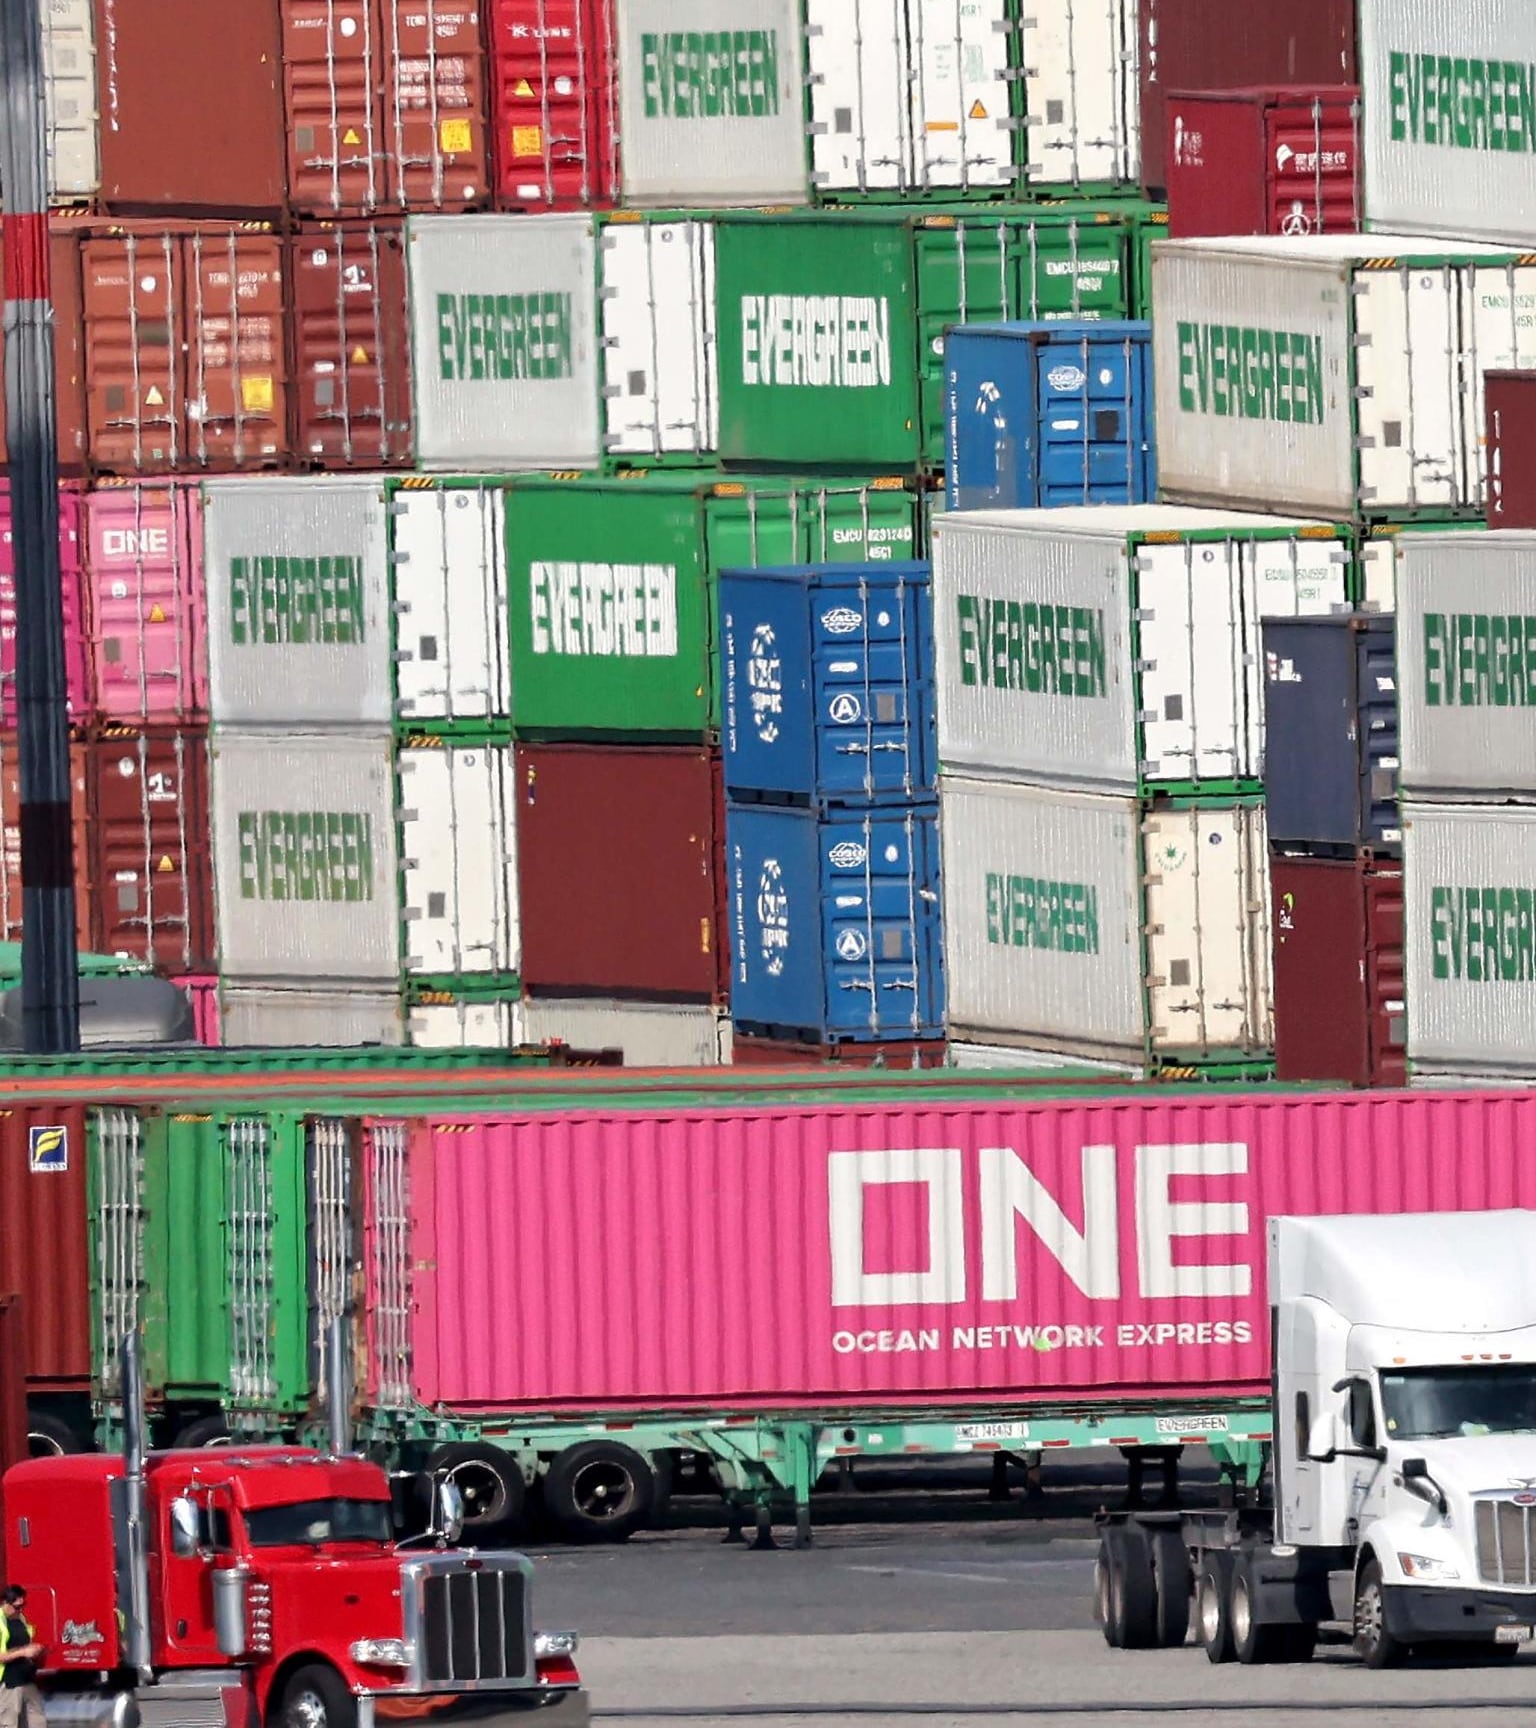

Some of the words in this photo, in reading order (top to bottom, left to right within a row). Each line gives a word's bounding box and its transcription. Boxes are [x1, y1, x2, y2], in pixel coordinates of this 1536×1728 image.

[644, 31, 778, 116] EVERGREEN
[438, 292, 573, 379] EVERGREEN
[740, 293, 892, 388] EVERGREEN
[1177, 321, 1324, 424] EVERGREEN
[103, 530, 168, 555] ONE
[832, 529, 864, 543] EMCU
[530, 561, 678, 656] EVERGREEN
[957, 594, 1106, 697] EVERGREEN
[827, 1142, 1254, 1306] ONE
[832, 1329, 940, 1354] OCEAN
[952, 1324, 1104, 1352] NETWORK
[1117, 1320, 1253, 1346] EXPRESS
[1157, 1416, 1227, 1432] EVERGREEN
